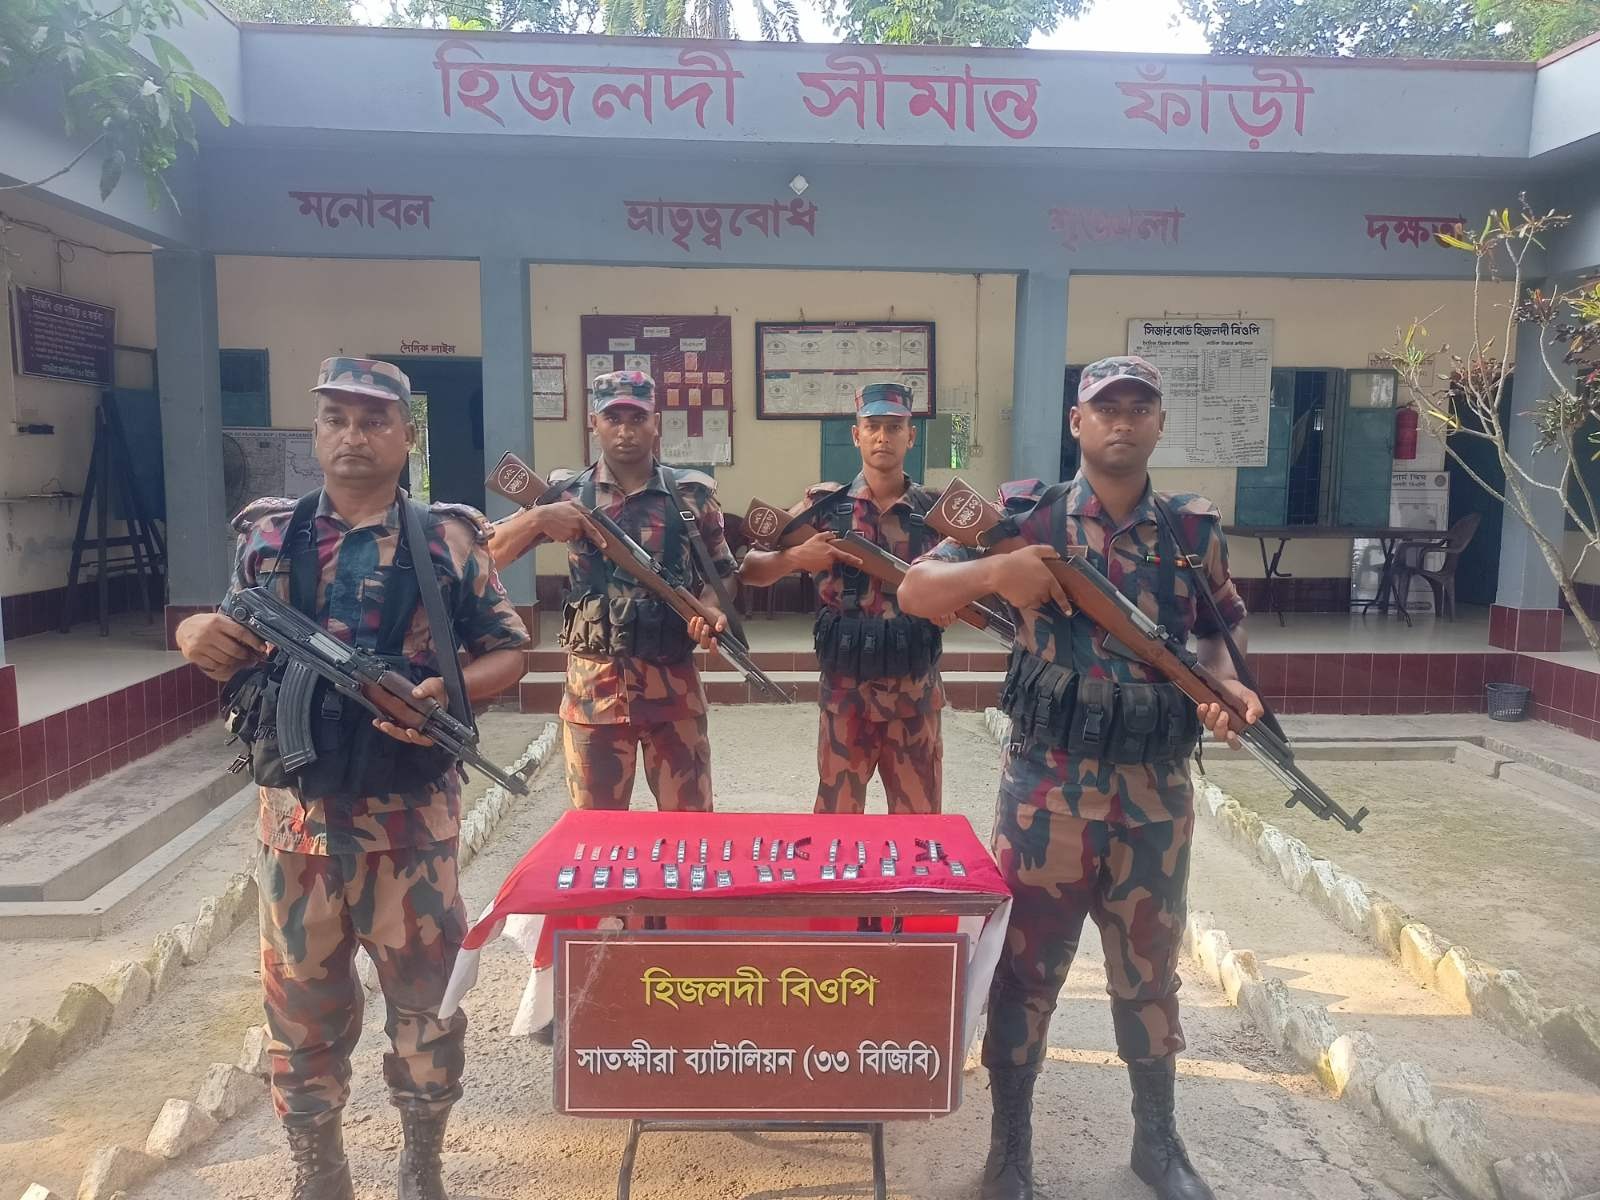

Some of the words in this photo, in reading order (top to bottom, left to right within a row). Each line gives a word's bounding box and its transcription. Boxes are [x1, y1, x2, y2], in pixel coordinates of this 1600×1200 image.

[433, 40, 745, 129] হিজলদী
[797, 50, 1041, 139] সীমান্ত
[1115, 63, 1315, 150] ফাঁড়ী
[288, 189, 434, 230] মনোবল
[623, 197, 818, 252] ভ্রাতৃত্ববোধ
[1194, 322, 1229, 337] হিজলদী
[1231, 322, 1260, 337] বিওপি
[640, 966, 769, 1009] হিজলদী
[778, 967, 881, 1007] বিওপি
[575, 1038, 678, 1076] সাতক্ষীরা
[683, 1039, 797, 1076] ব্যাটালিয়ন
[803, 1044, 850, 1081] (৩৩
[857, 1040, 941, 1081] বিজিবি)
